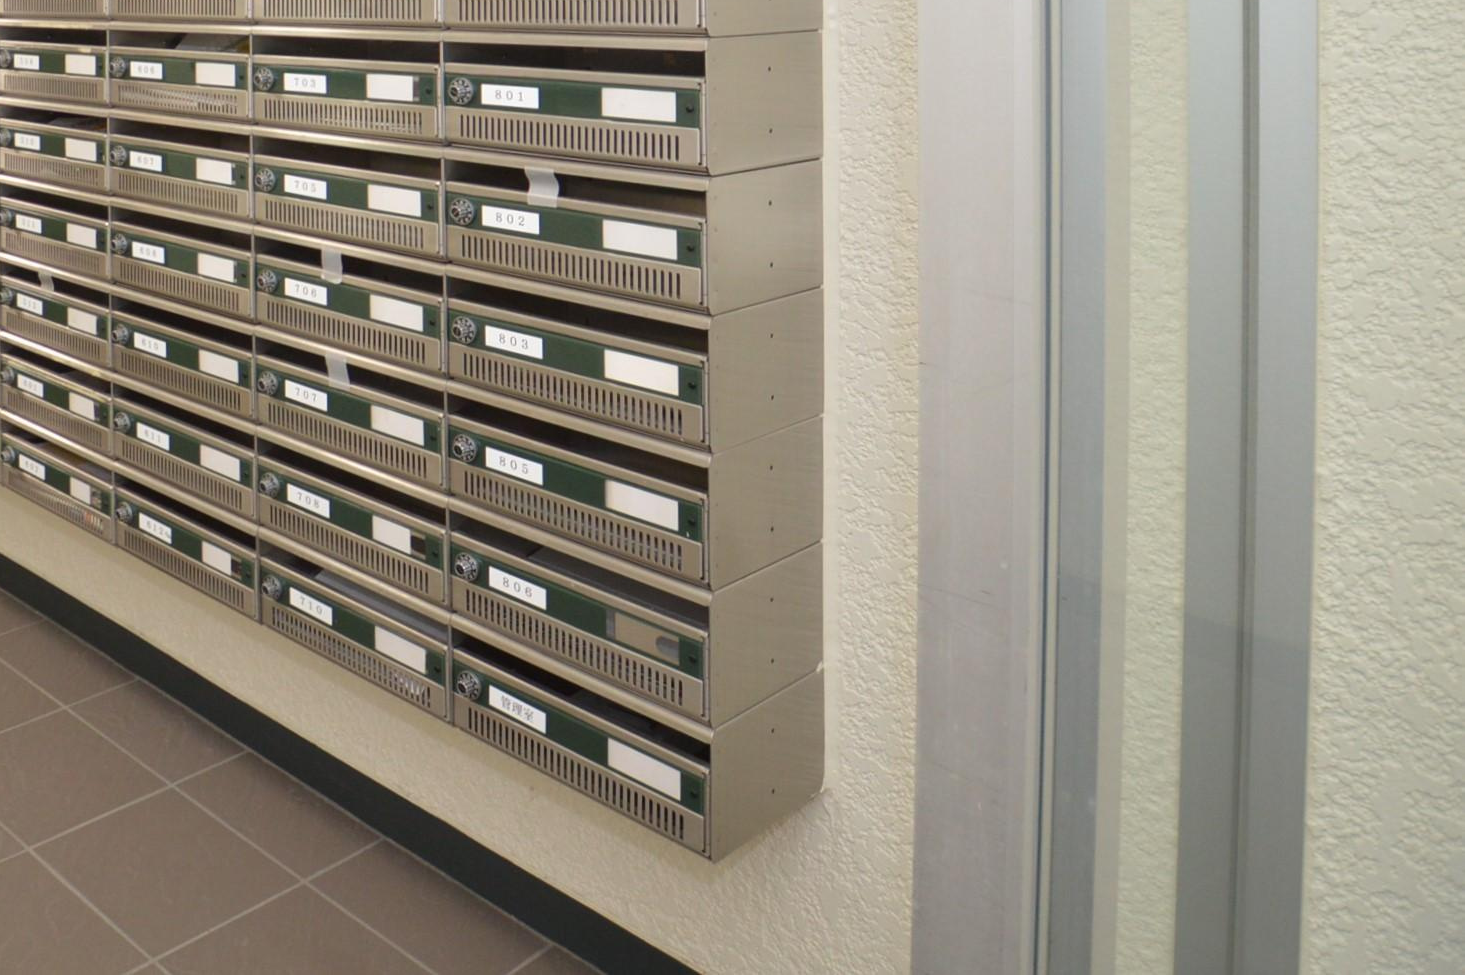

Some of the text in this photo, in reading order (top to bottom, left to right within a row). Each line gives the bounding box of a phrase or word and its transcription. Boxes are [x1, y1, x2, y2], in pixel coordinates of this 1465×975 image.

[495, 89, 524, 102] 801
[495, 212, 525, 227] 802
[499, 333, 529, 350] 803
[295, 387, 317, 403] 707
[499, 456, 529, 475] 805
[502, 578, 533, 598] 806
[500, 695, 534, 721] 管理室
